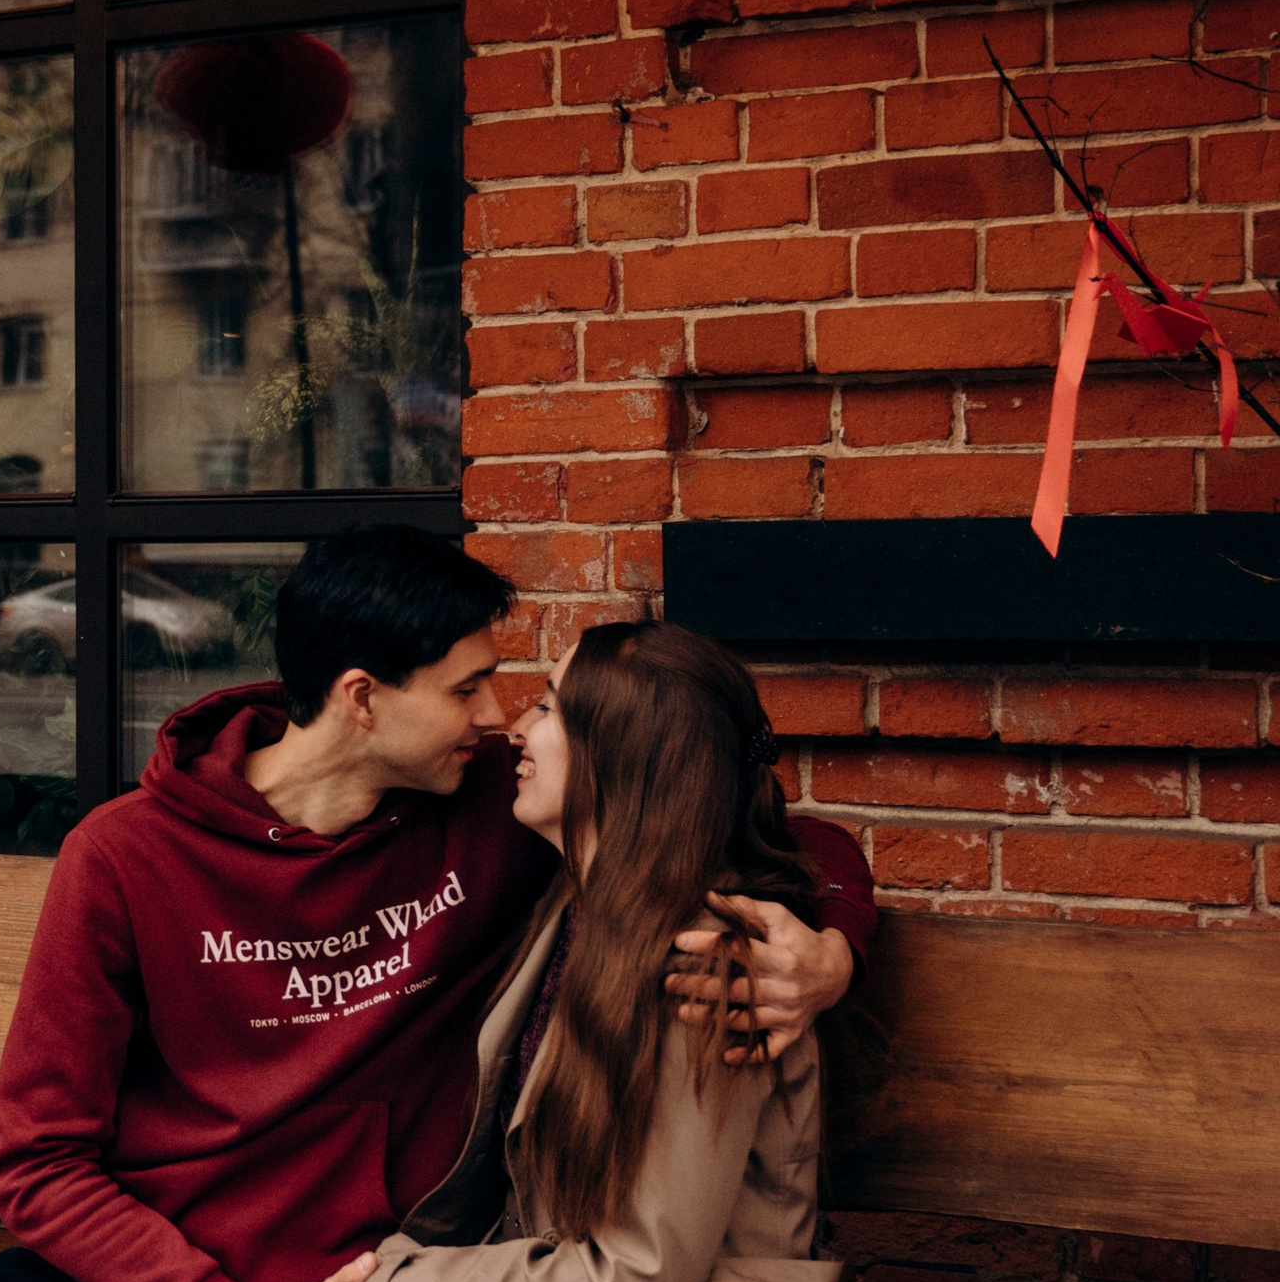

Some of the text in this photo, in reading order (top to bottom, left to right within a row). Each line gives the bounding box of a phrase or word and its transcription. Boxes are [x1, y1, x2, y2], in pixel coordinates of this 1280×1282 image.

[200, 871, 466, 963] Menswear Wknd
[250, 974, 439, 1028] TOKYO MOSCOW BARCELONA LONDON
[282, 943, 412, 1008] Apparel
